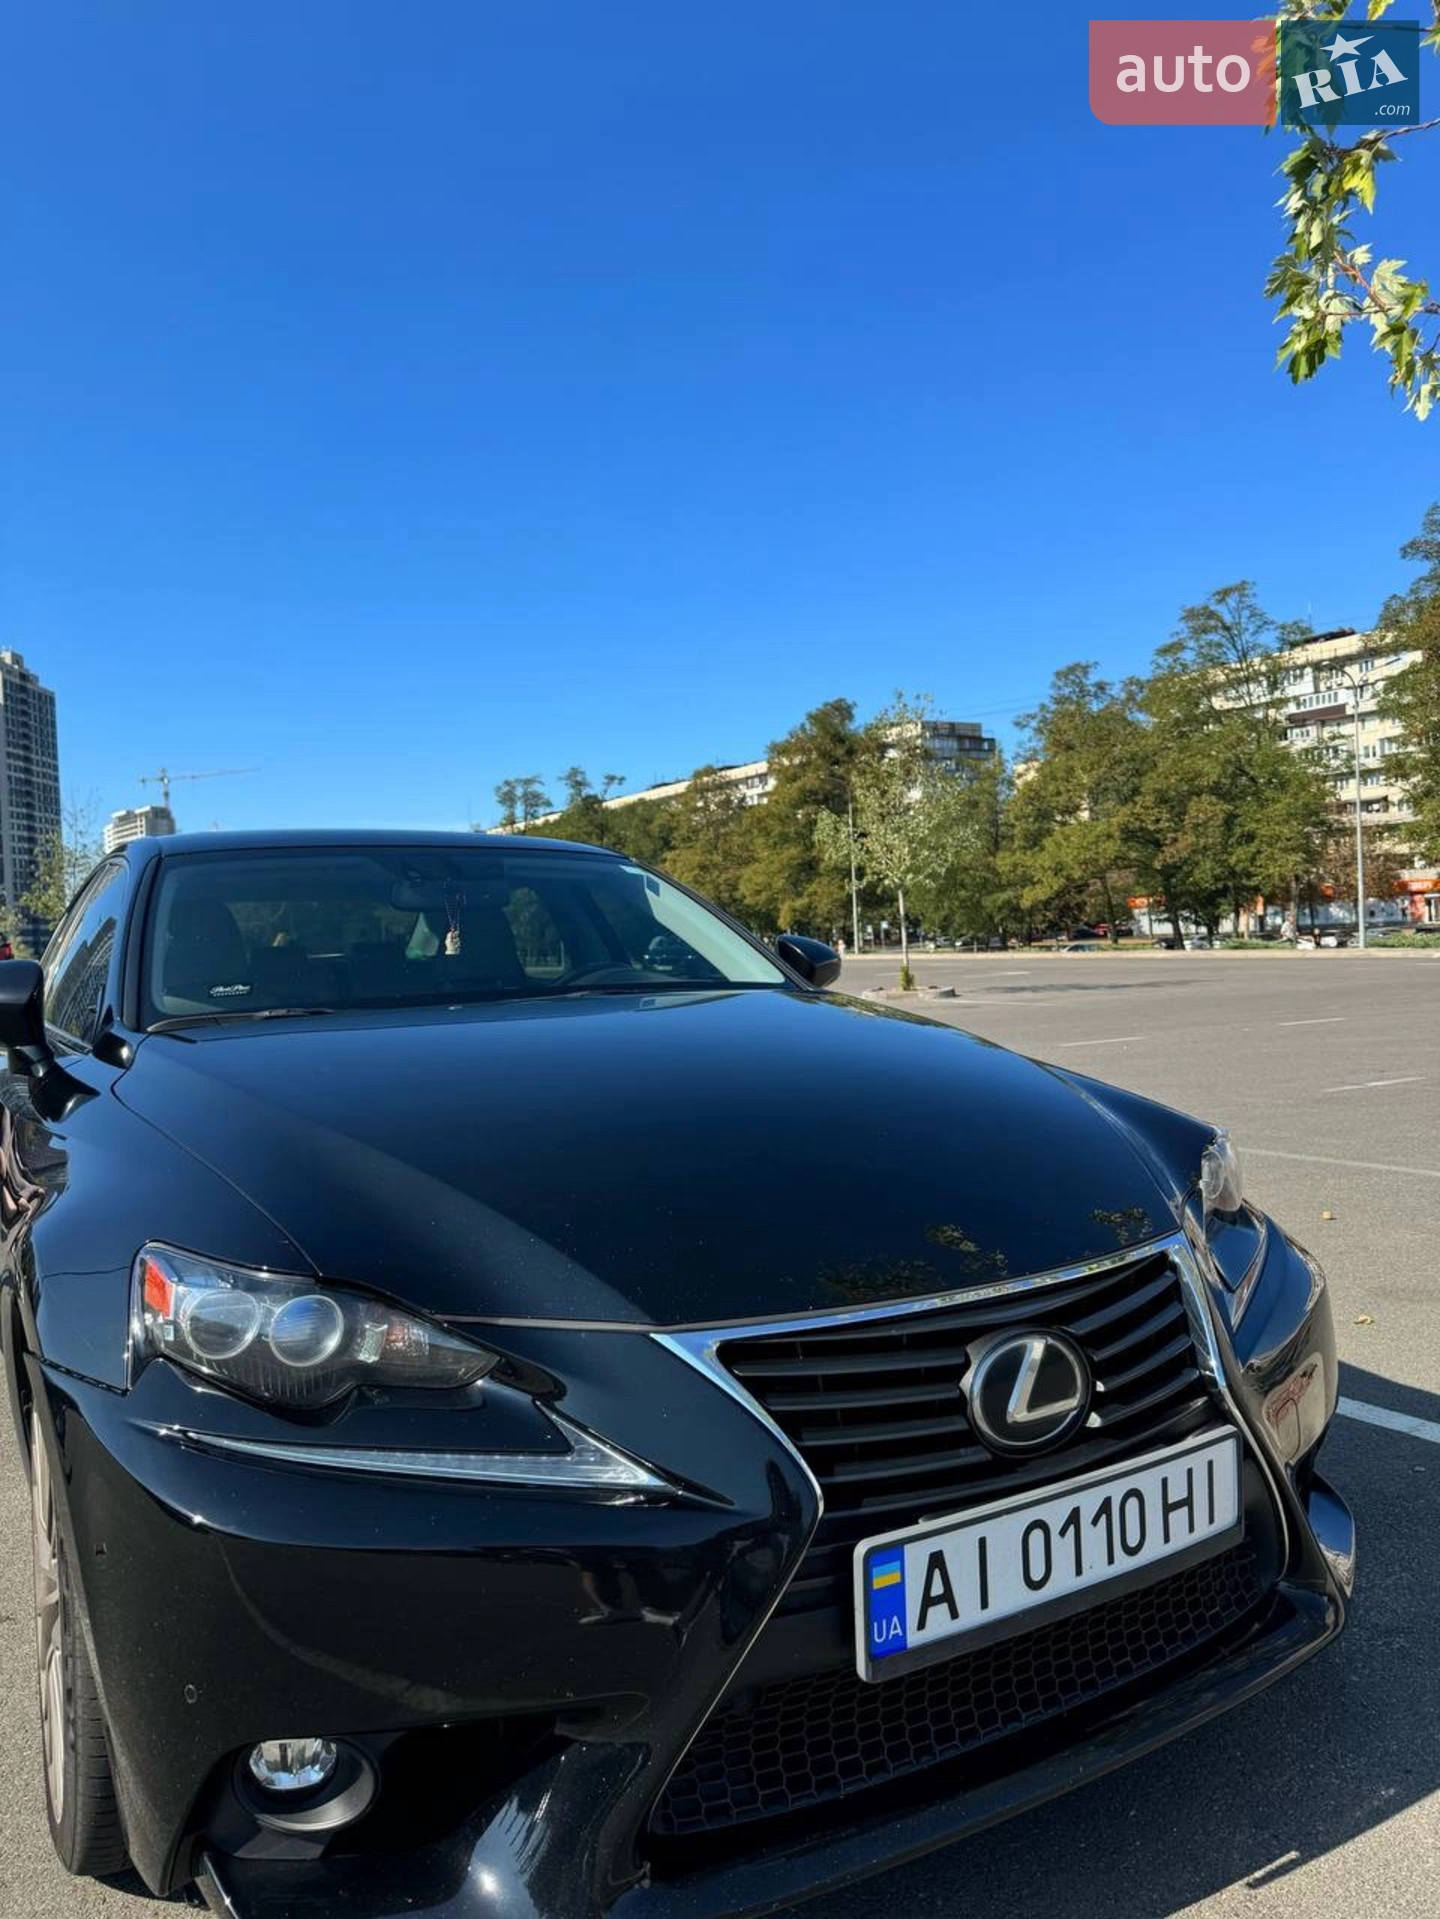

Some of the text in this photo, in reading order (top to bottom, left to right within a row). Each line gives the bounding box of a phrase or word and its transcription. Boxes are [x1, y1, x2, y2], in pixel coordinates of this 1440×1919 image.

[916, 1459, 1215, 1631] AI 0110 HI
[873, 1615, 903, 1644] UA
